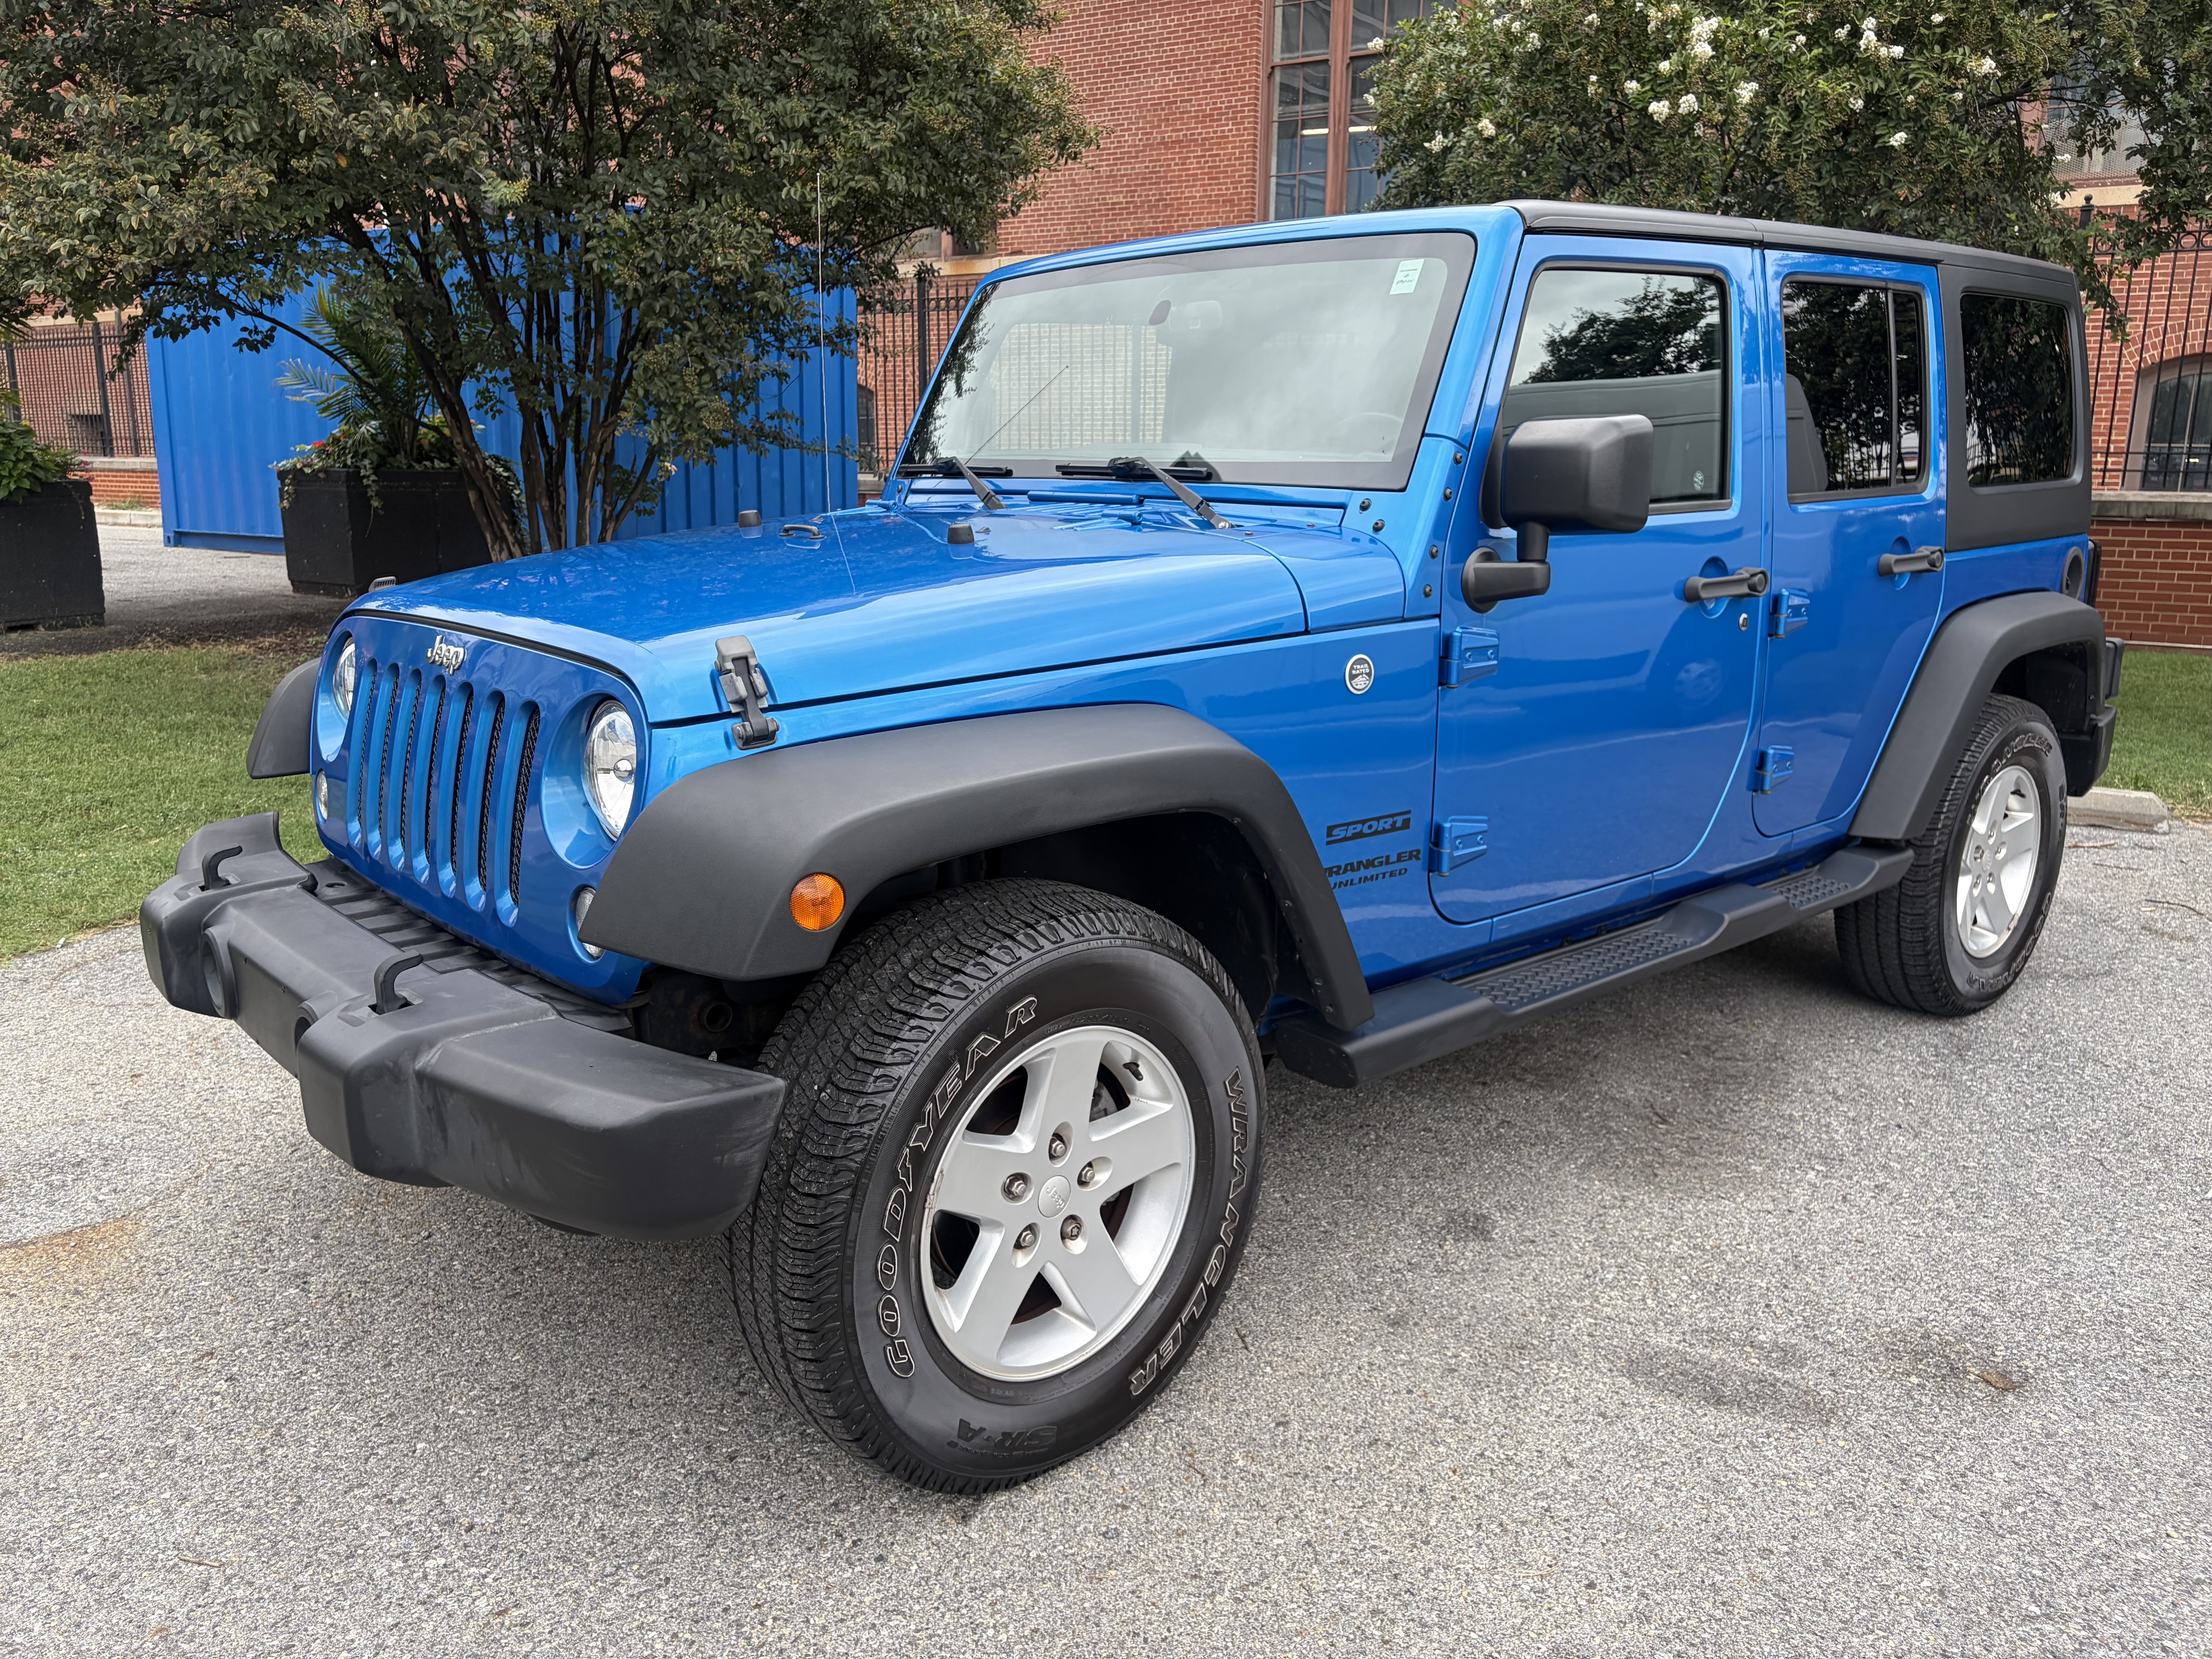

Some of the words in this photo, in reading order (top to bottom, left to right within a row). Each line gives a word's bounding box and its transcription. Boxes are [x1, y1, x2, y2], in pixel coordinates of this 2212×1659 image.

[427, 635, 464, 675] Jeep
[1329, 816, 1411, 840] SPORT
[1325, 849, 1421, 878] RANGLER
[877, 995, 1037, 1378] GOODYEAR
[1046, 1186, 1065, 1209] Jeep
[1128, 1066, 1248, 1396] WRANGLER
